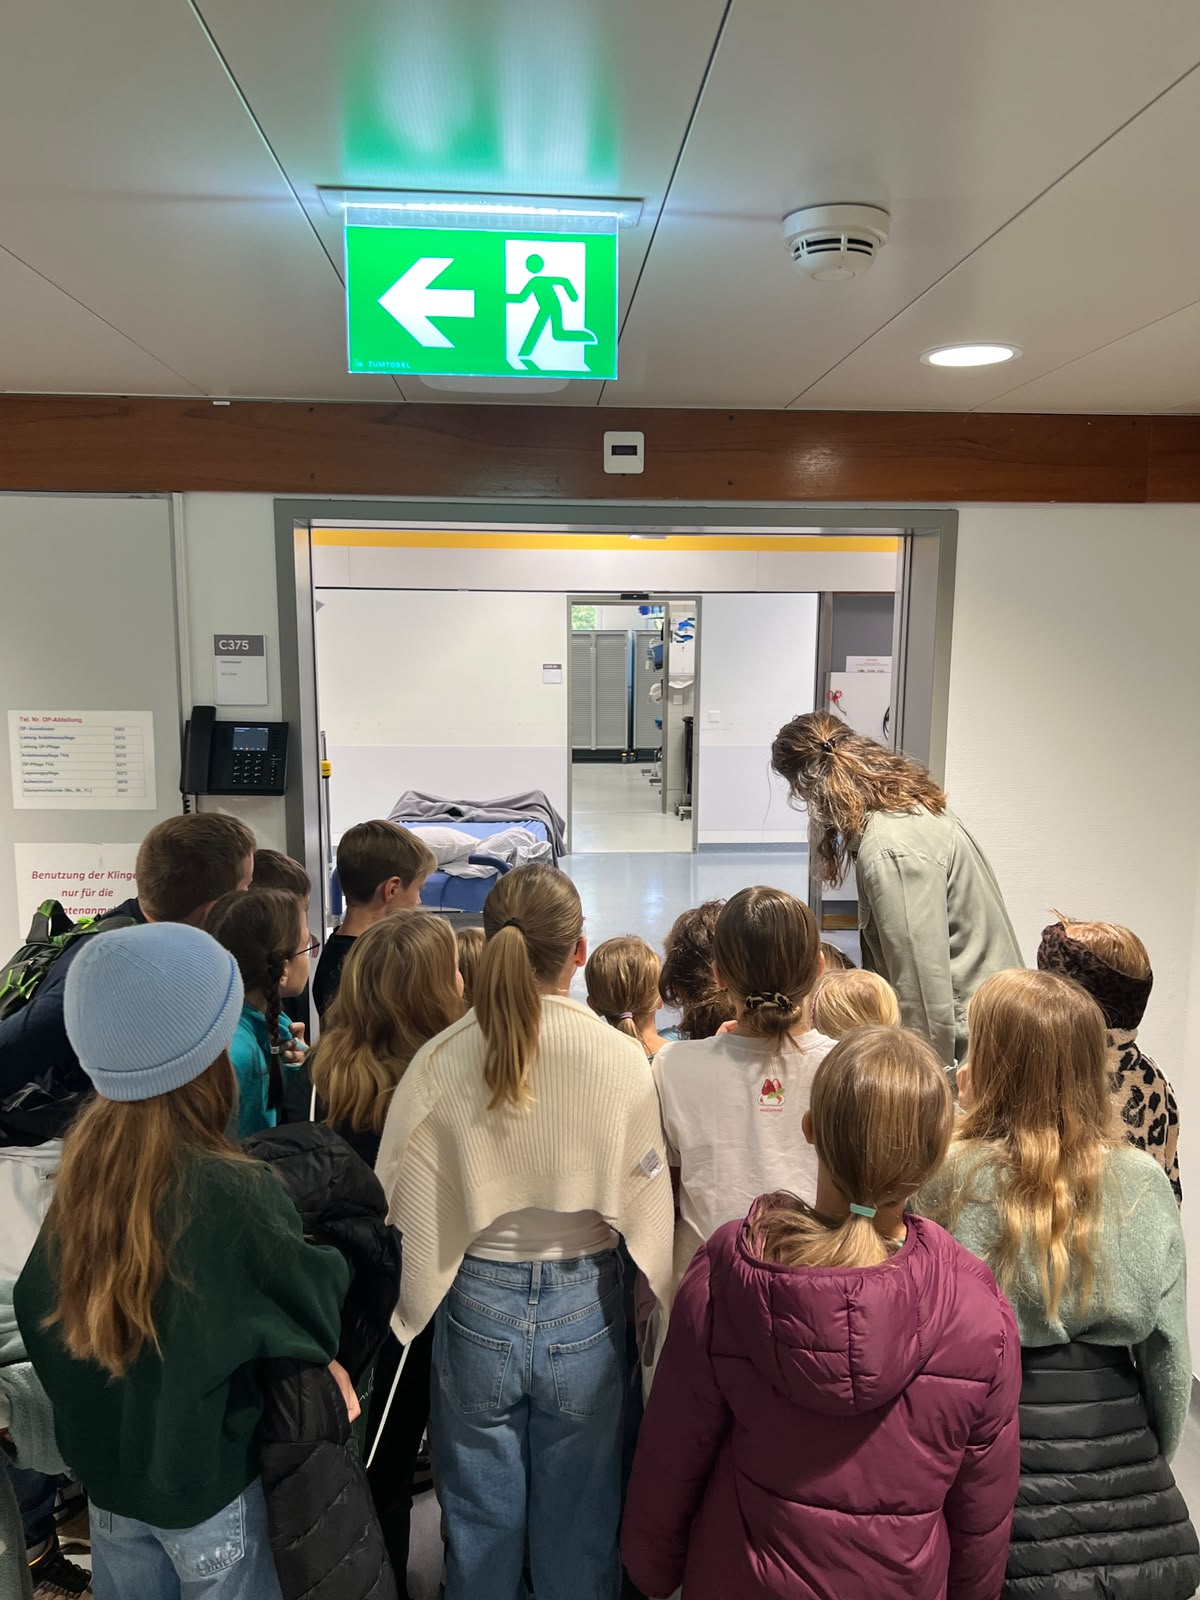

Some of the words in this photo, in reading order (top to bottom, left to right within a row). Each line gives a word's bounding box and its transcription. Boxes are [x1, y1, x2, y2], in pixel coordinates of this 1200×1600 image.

[218, 639, 250, 651] C375
[32, 871, 85, 881] Benutzung
[88, 871, 105, 880] der
[107, 871, 137, 881] Klinge
[61, 889, 79, 897] nur
[80, 888, 96, 898] für
[98, 888, 114, 897] die
